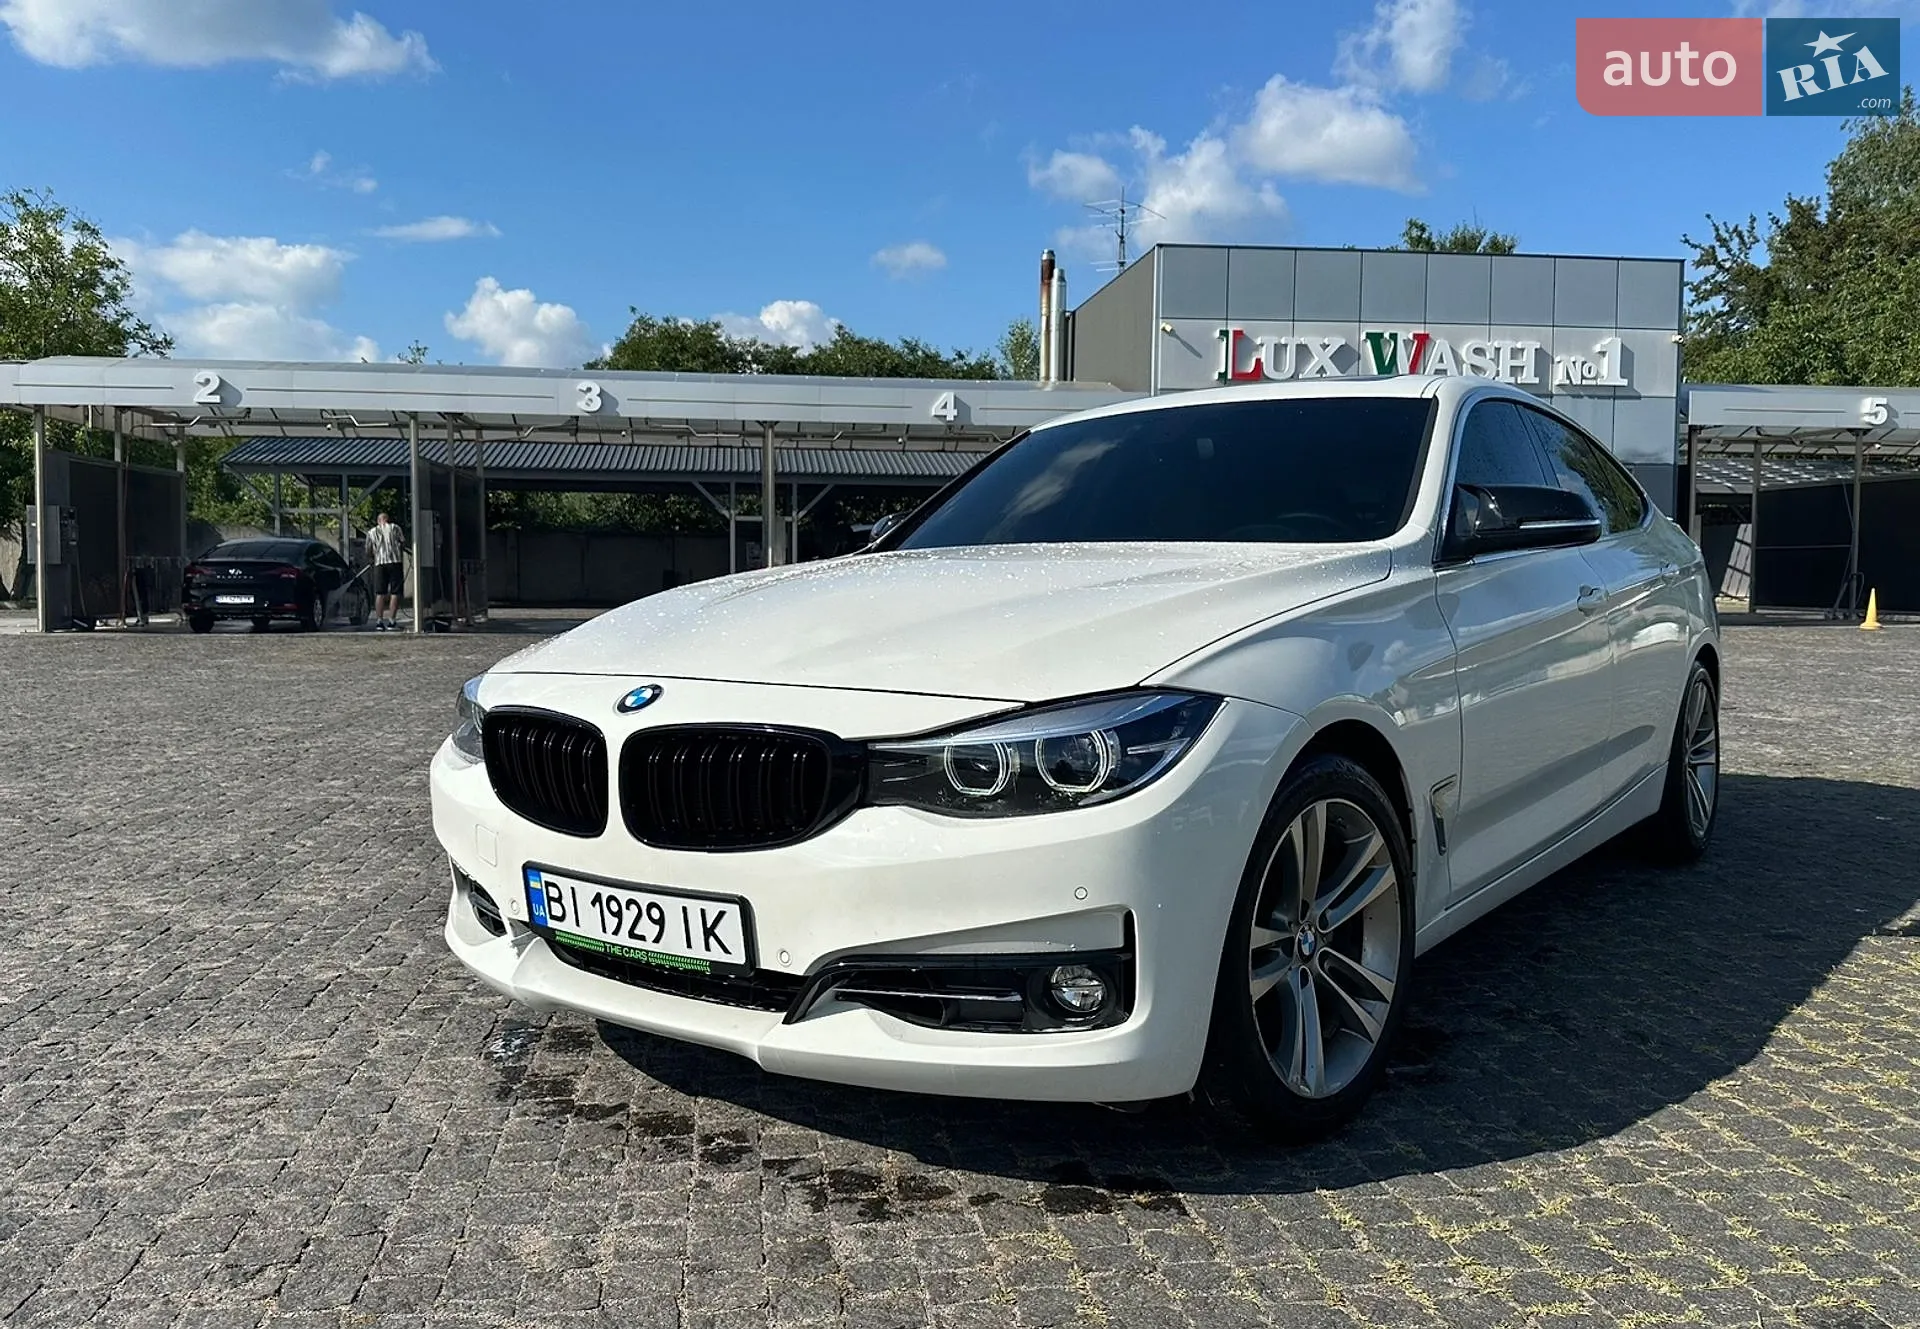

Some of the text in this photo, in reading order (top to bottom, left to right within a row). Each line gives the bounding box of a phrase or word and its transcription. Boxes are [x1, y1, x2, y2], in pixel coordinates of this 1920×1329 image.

[1216, 328, 1346, 380] LUX
[1362, 331, 1541, 384] WASH
[193, 371, 221, 403] 2
[577, 381, 602, 412] 3
[932, 391, 958, 421] 4
[1862, 397, 1888, 425] 5
[532, 903, 546, 917] UA
[544, 880, 732, 955] BI 1929 IK
[605, 943, 648, 961] THE CARS
